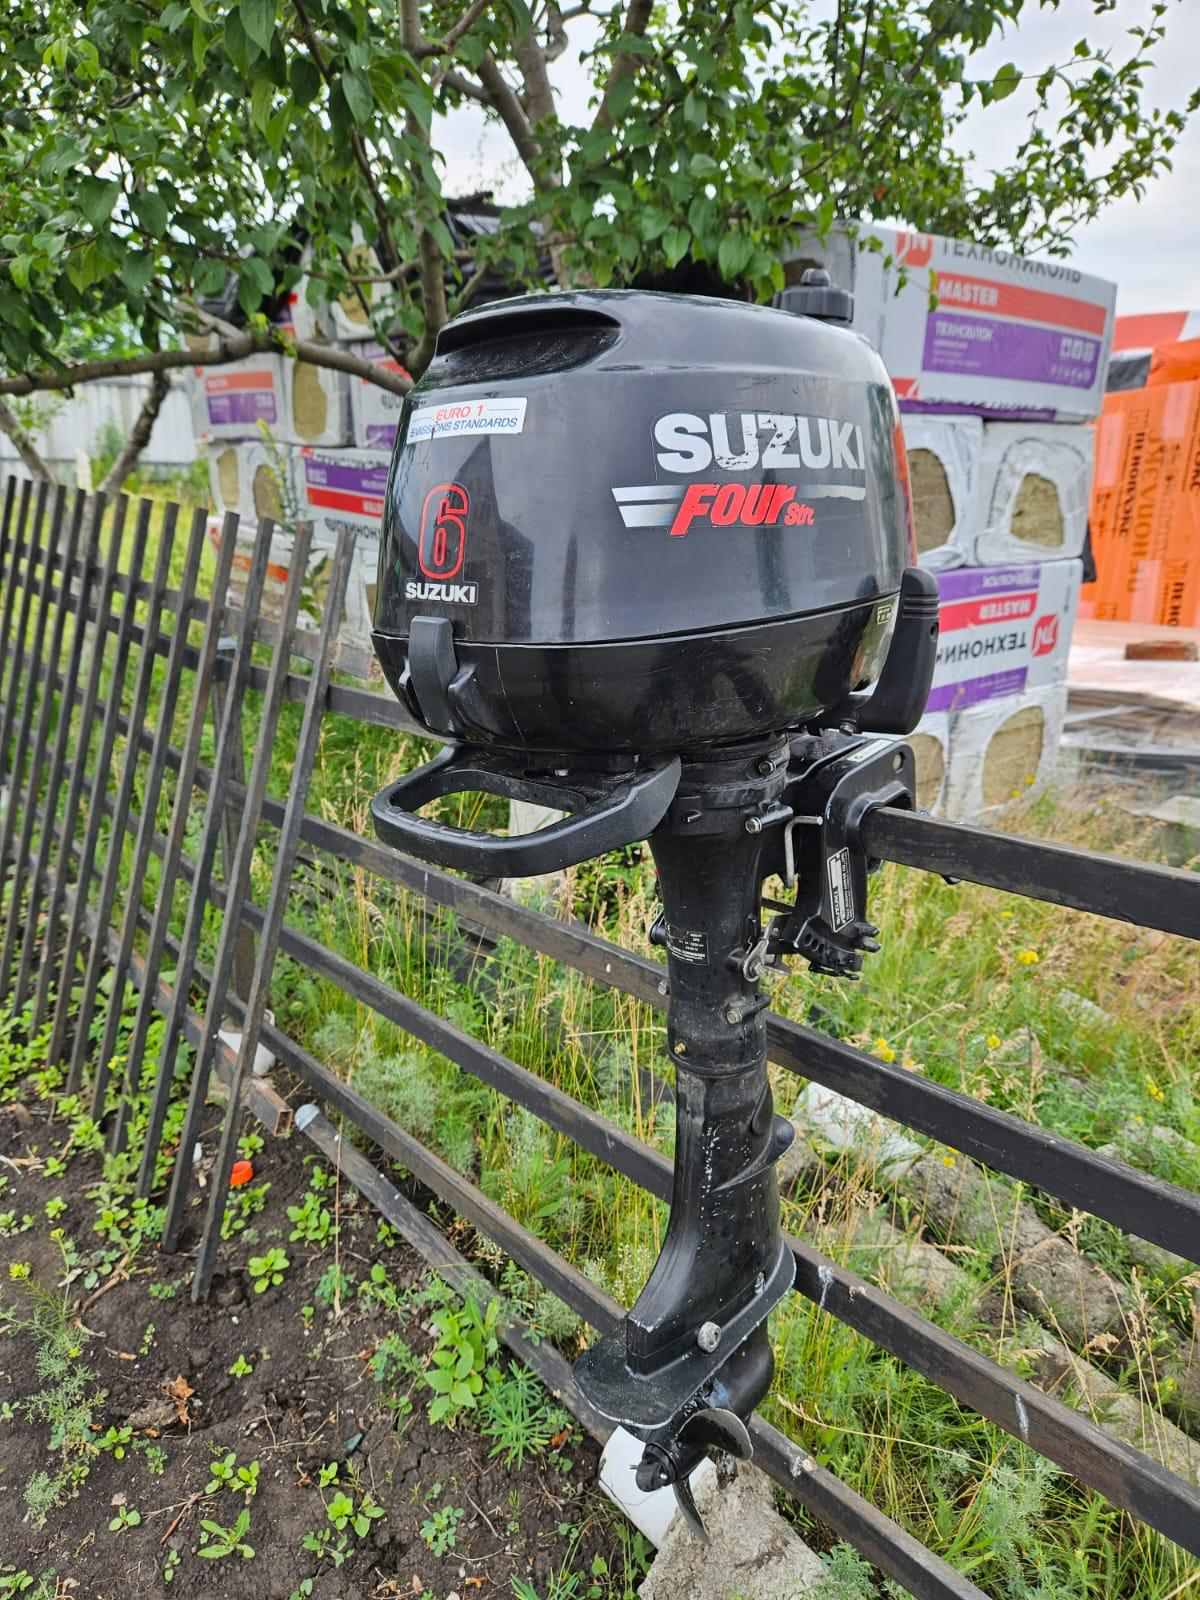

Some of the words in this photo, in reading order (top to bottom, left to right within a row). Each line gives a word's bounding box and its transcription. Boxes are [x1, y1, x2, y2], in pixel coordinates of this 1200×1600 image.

[938, 279, 998, 306] MASTER
[436, 406, 471, 421] EURO
[478, 404, 485, 417] 1
[454, 416, 518, 430] STANDARDS
[654, 413, 865, 473] SUZUKI
[418, 482, 469, 580] 6
[405, 582, 476, 603] SUZUKI
